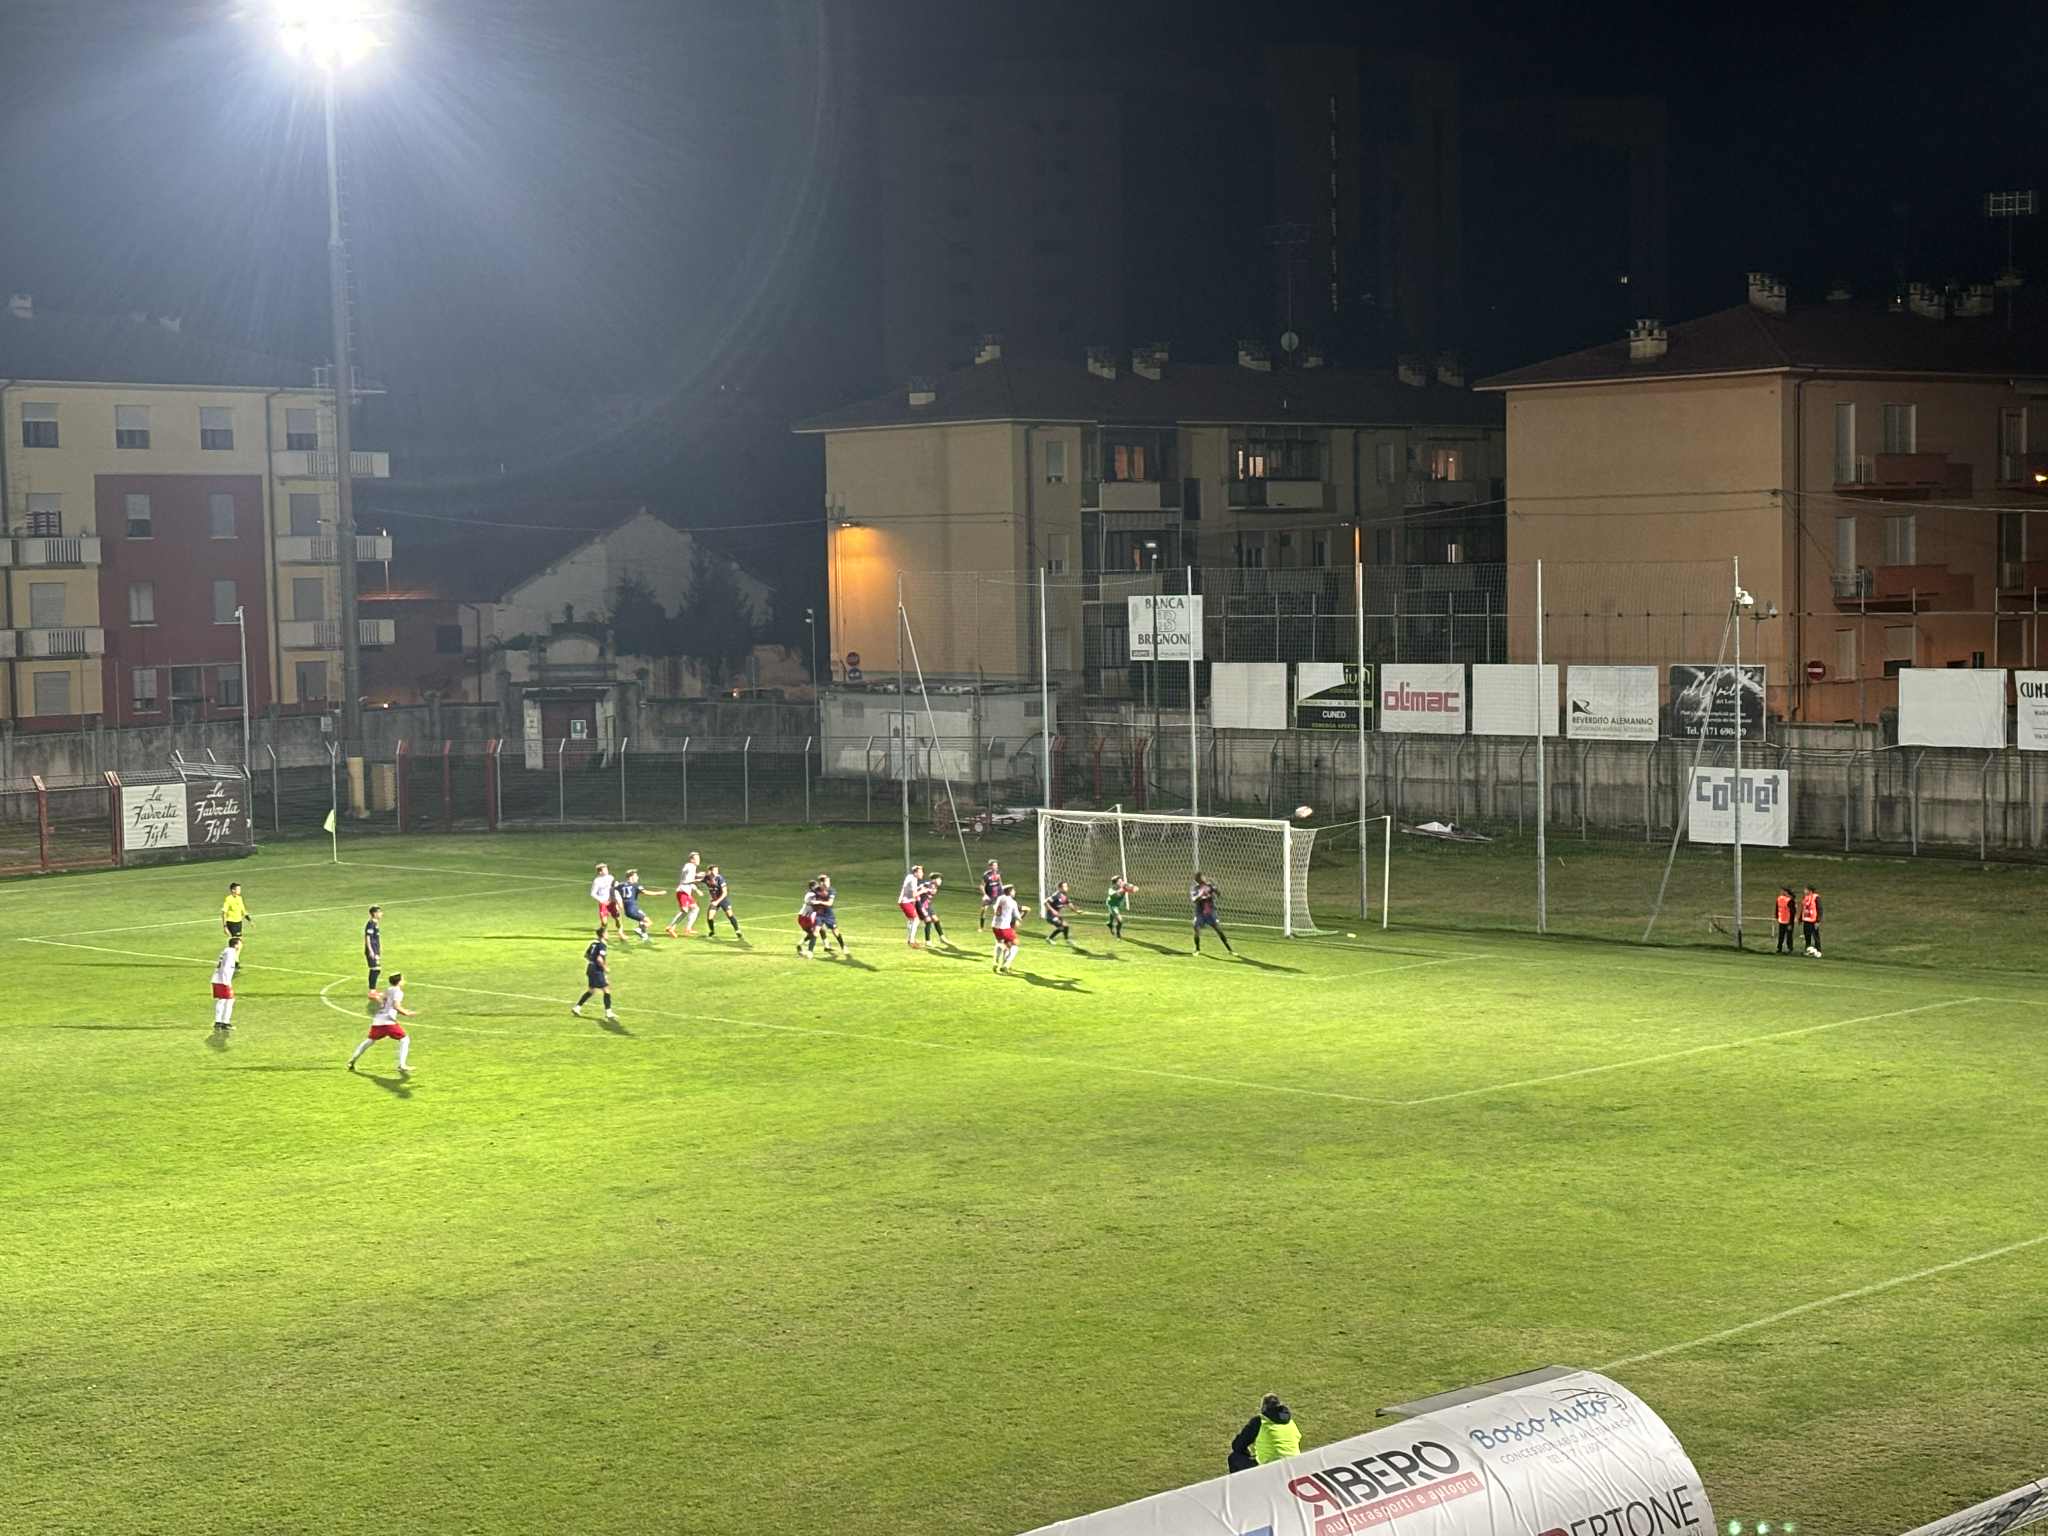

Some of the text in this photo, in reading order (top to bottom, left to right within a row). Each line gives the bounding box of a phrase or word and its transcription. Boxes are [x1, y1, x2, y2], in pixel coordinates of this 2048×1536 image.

[1145, 598, 1184, 609] BANCA
[1138, 633, 1192, 645] BRGNON
[1384, 681, 1460, 712] olimac
[1322, 710, 1346, 719] CUNEO
[1611, 717, 1654, 726] ALEMANNO
[145, 786, 163, 802] La
[206, 782, 225, 798] La
[133, 803, 179, 826] Favorita
[194, 798, 241, 824] Favorita
[1469, 1416, 1546, 1450] Bosco
[1550, 1398, 1608, 1428] Auto
[1288, 1441, 1460, 1517] RIBERO
[1325, 1475, 1480, 1534] autotrasporti e autogru
[1538, 1484, 1700, 1536] RTONE
